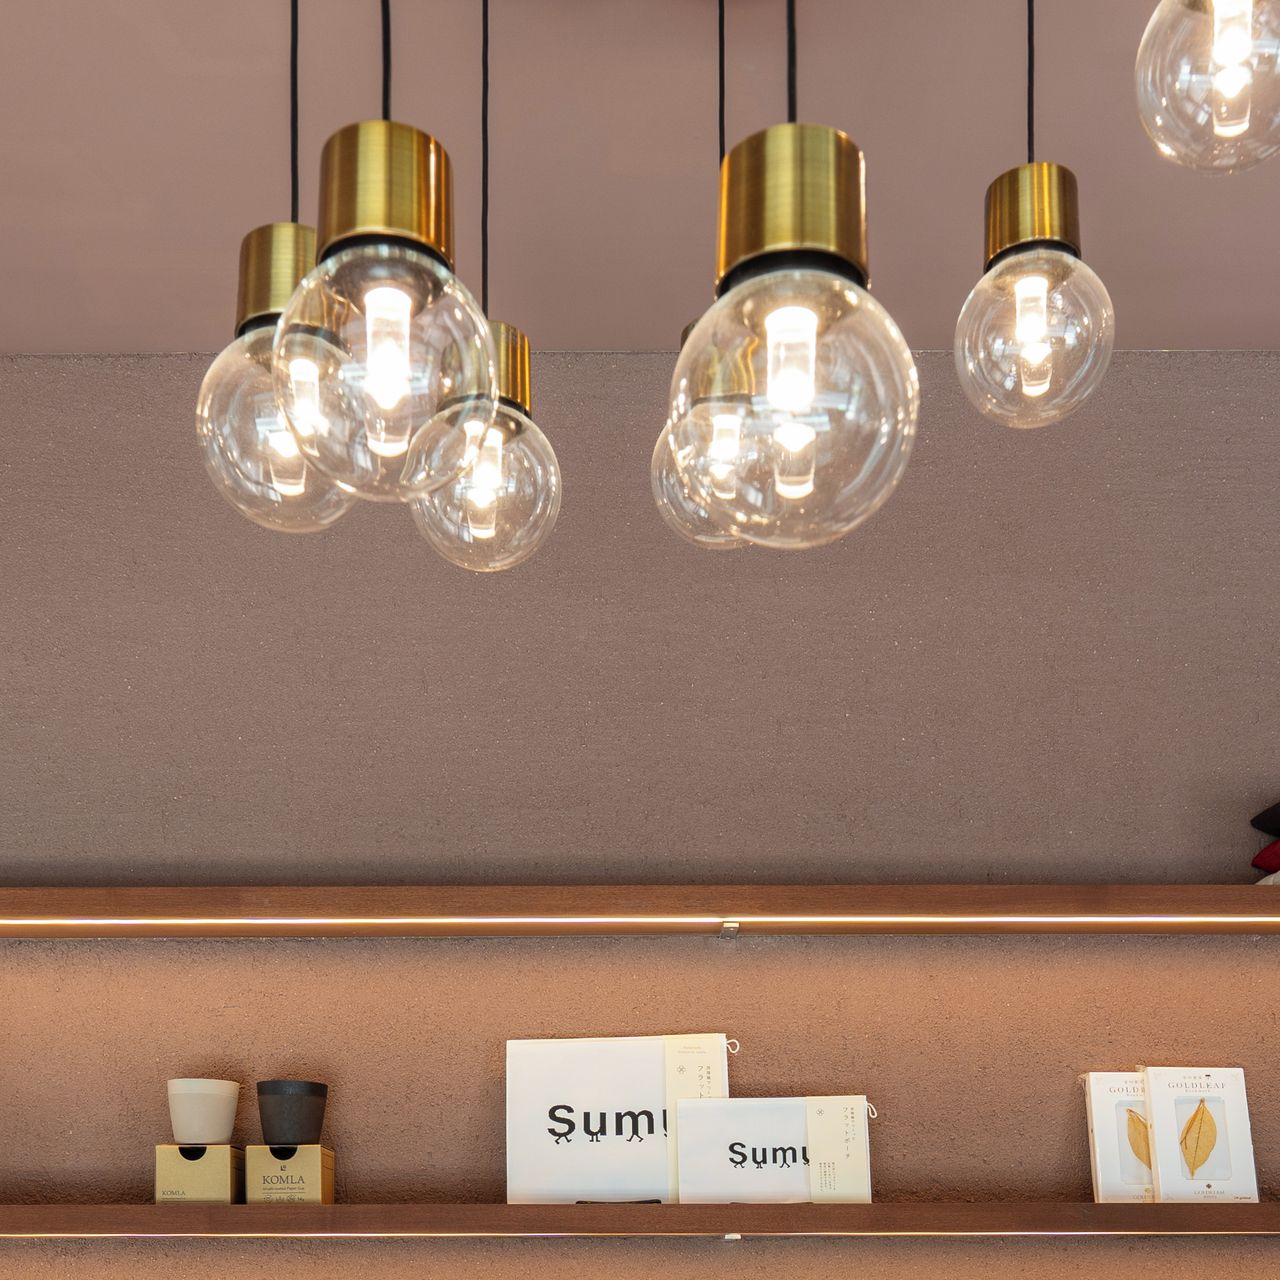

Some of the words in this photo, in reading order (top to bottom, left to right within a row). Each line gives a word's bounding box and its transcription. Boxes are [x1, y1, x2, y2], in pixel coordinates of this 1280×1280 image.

[1168, 1081, 1226, 1089] GOLDLEAF
[547, 1104, 667, 1145] Sum
[262, 1175, 305, 1185] KOMLA
